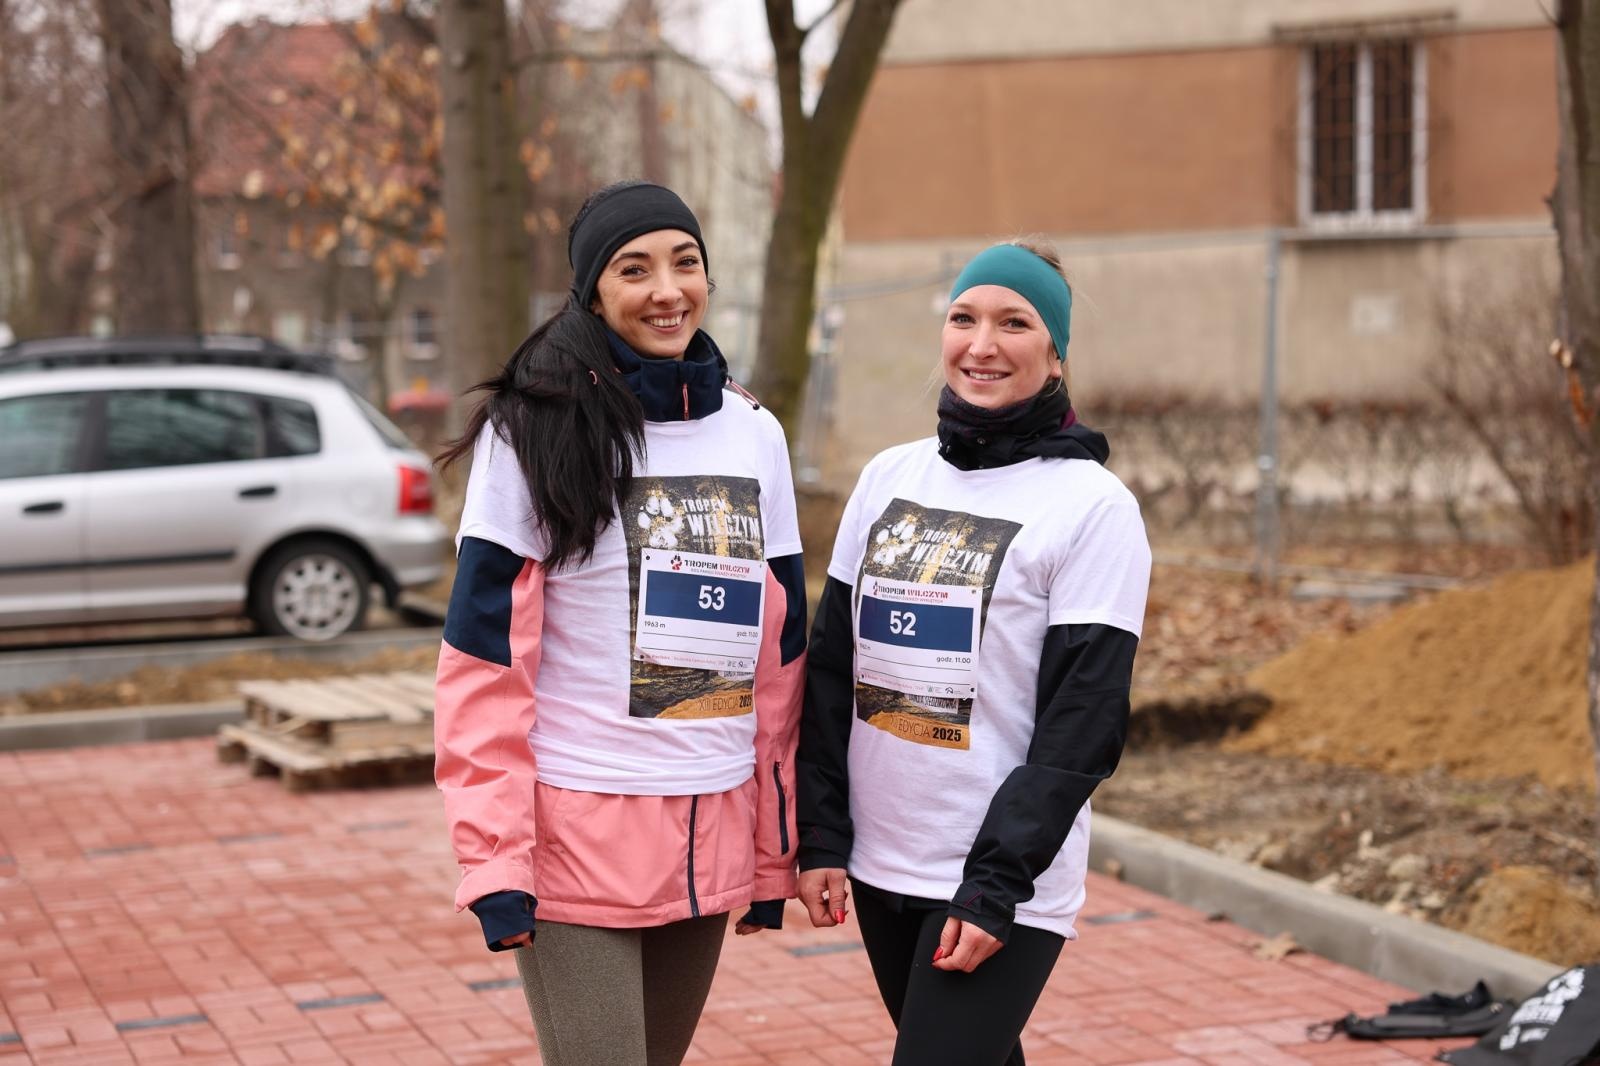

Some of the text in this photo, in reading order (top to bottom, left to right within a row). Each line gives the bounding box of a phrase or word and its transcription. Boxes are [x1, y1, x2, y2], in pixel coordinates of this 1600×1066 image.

[681, 499, 730, 513] TROPEM
[687, 514, 761, 541] WILCZYM
[921, 529, 961, 545] TROPEM
[684, 559, 750, 573] TROPEM WILCZYM
[910, 542, 993, 574] WILCZYM
[698, 584, 726, 611] 53
[878, 586, 906, 595] TROPEM
[907, 589, 948, 599] WILCZYM
[889, 610, 917, 636] 52
[712, 697, 739, 710] EDYCJA
[898, 718, 931, 737] EDYCJA
[932, 727, 962, 742] 2025
